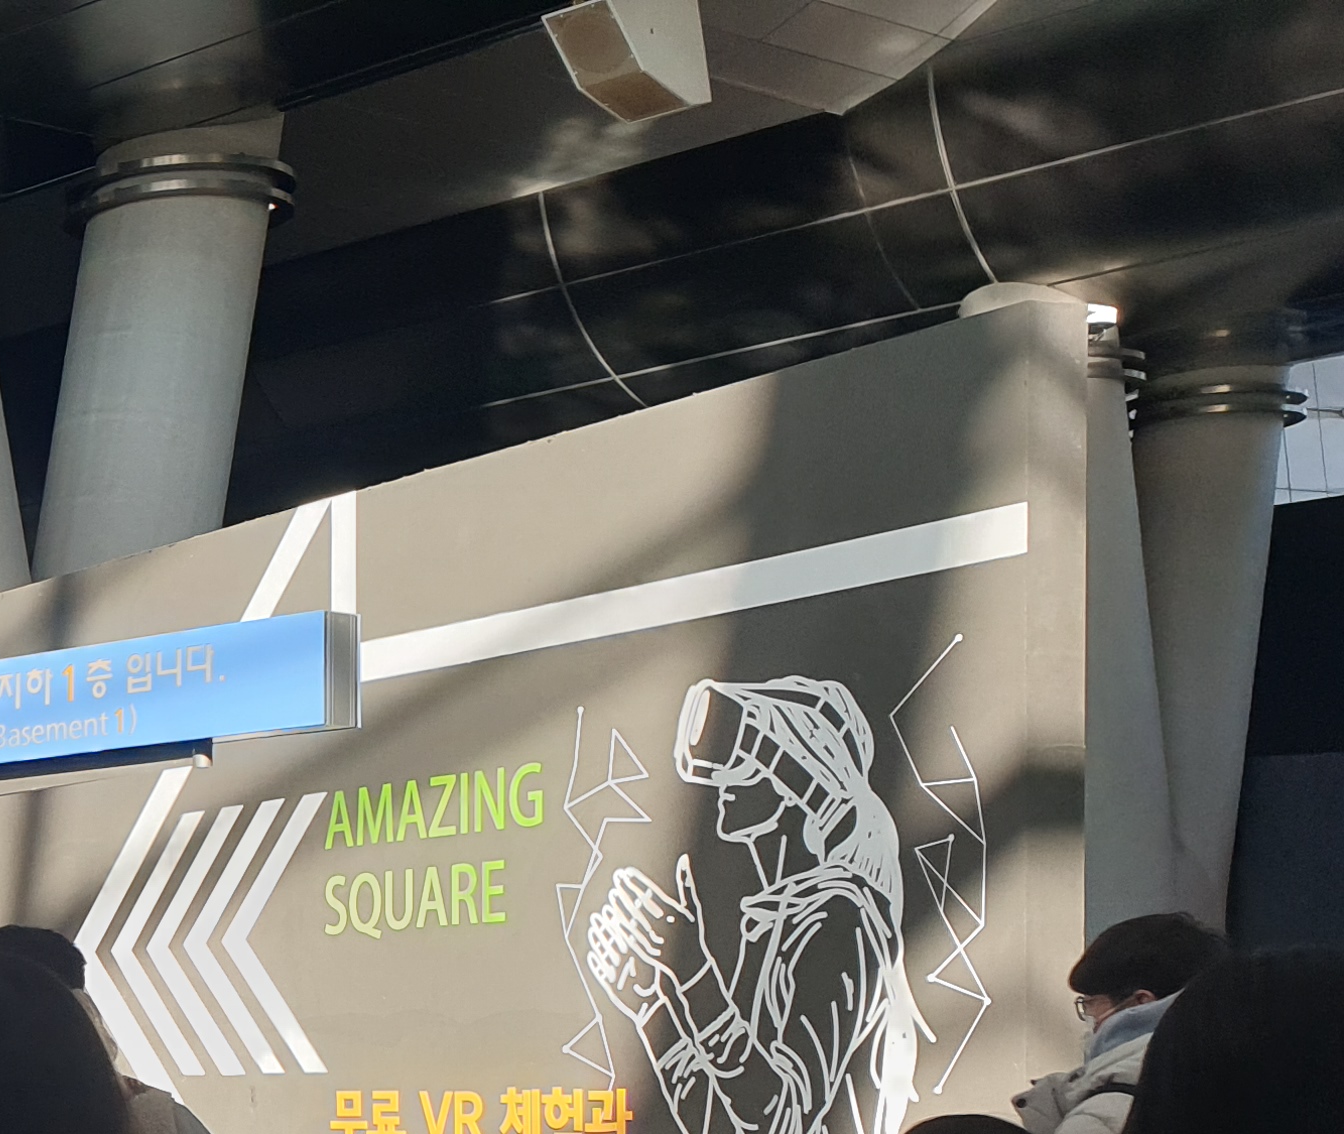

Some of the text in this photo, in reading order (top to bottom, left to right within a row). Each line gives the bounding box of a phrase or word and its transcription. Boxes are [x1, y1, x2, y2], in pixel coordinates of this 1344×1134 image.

[61, 663, 75, 703] 1
[86, 658, 113, 700] 층
[126, 643, 225, 695] 입니다.
[324, 762, 545, 851] AMAZING
[323, 859, 507, 940] SQUARE
